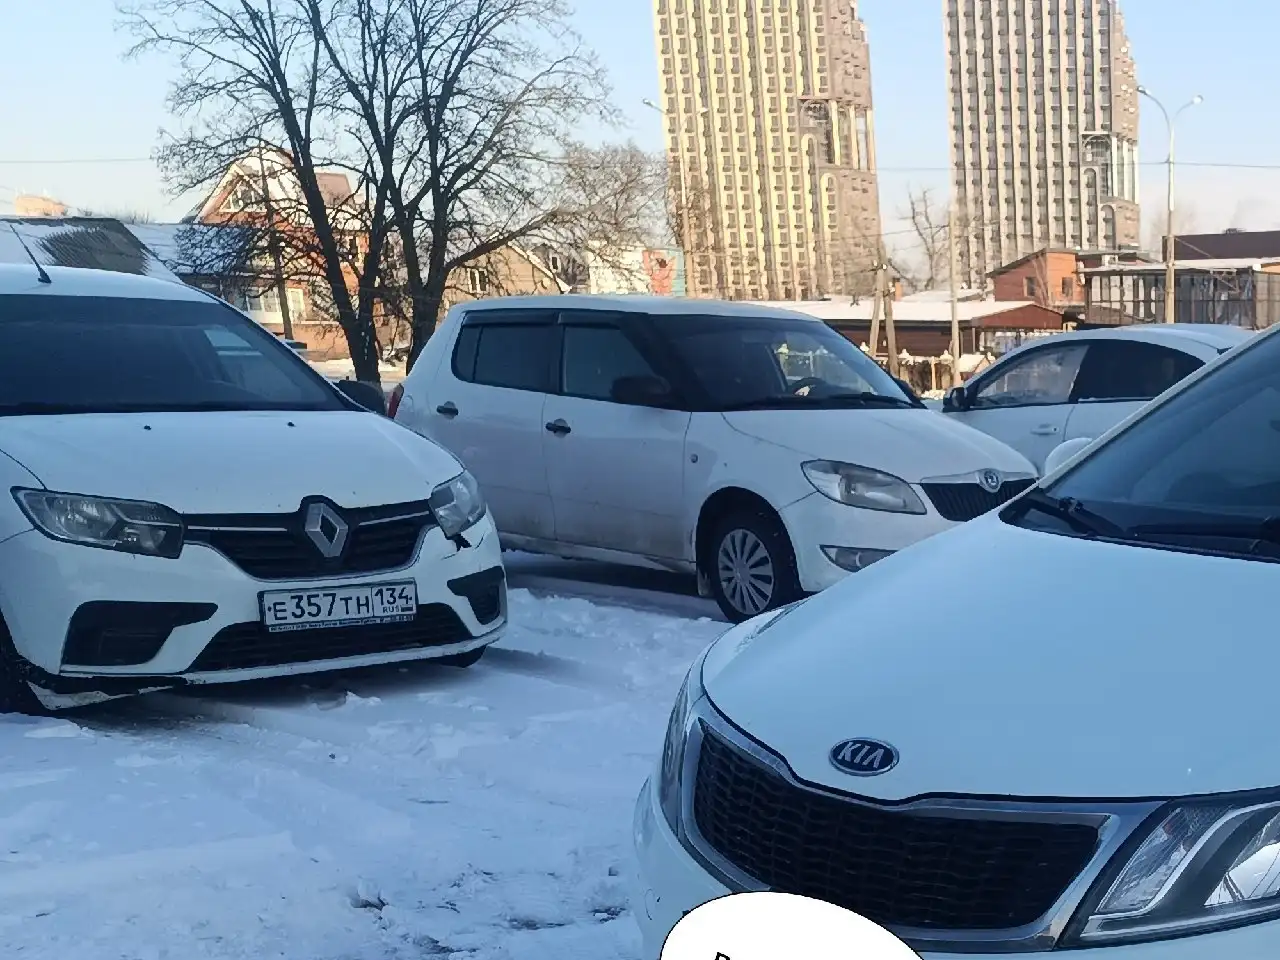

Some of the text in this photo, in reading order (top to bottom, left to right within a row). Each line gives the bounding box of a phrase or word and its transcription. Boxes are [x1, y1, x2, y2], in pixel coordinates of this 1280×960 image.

[374, 587, 411, 606] 134
[383, 603, 400, 613] RUS
[837, 741, 885, 769] KIA
